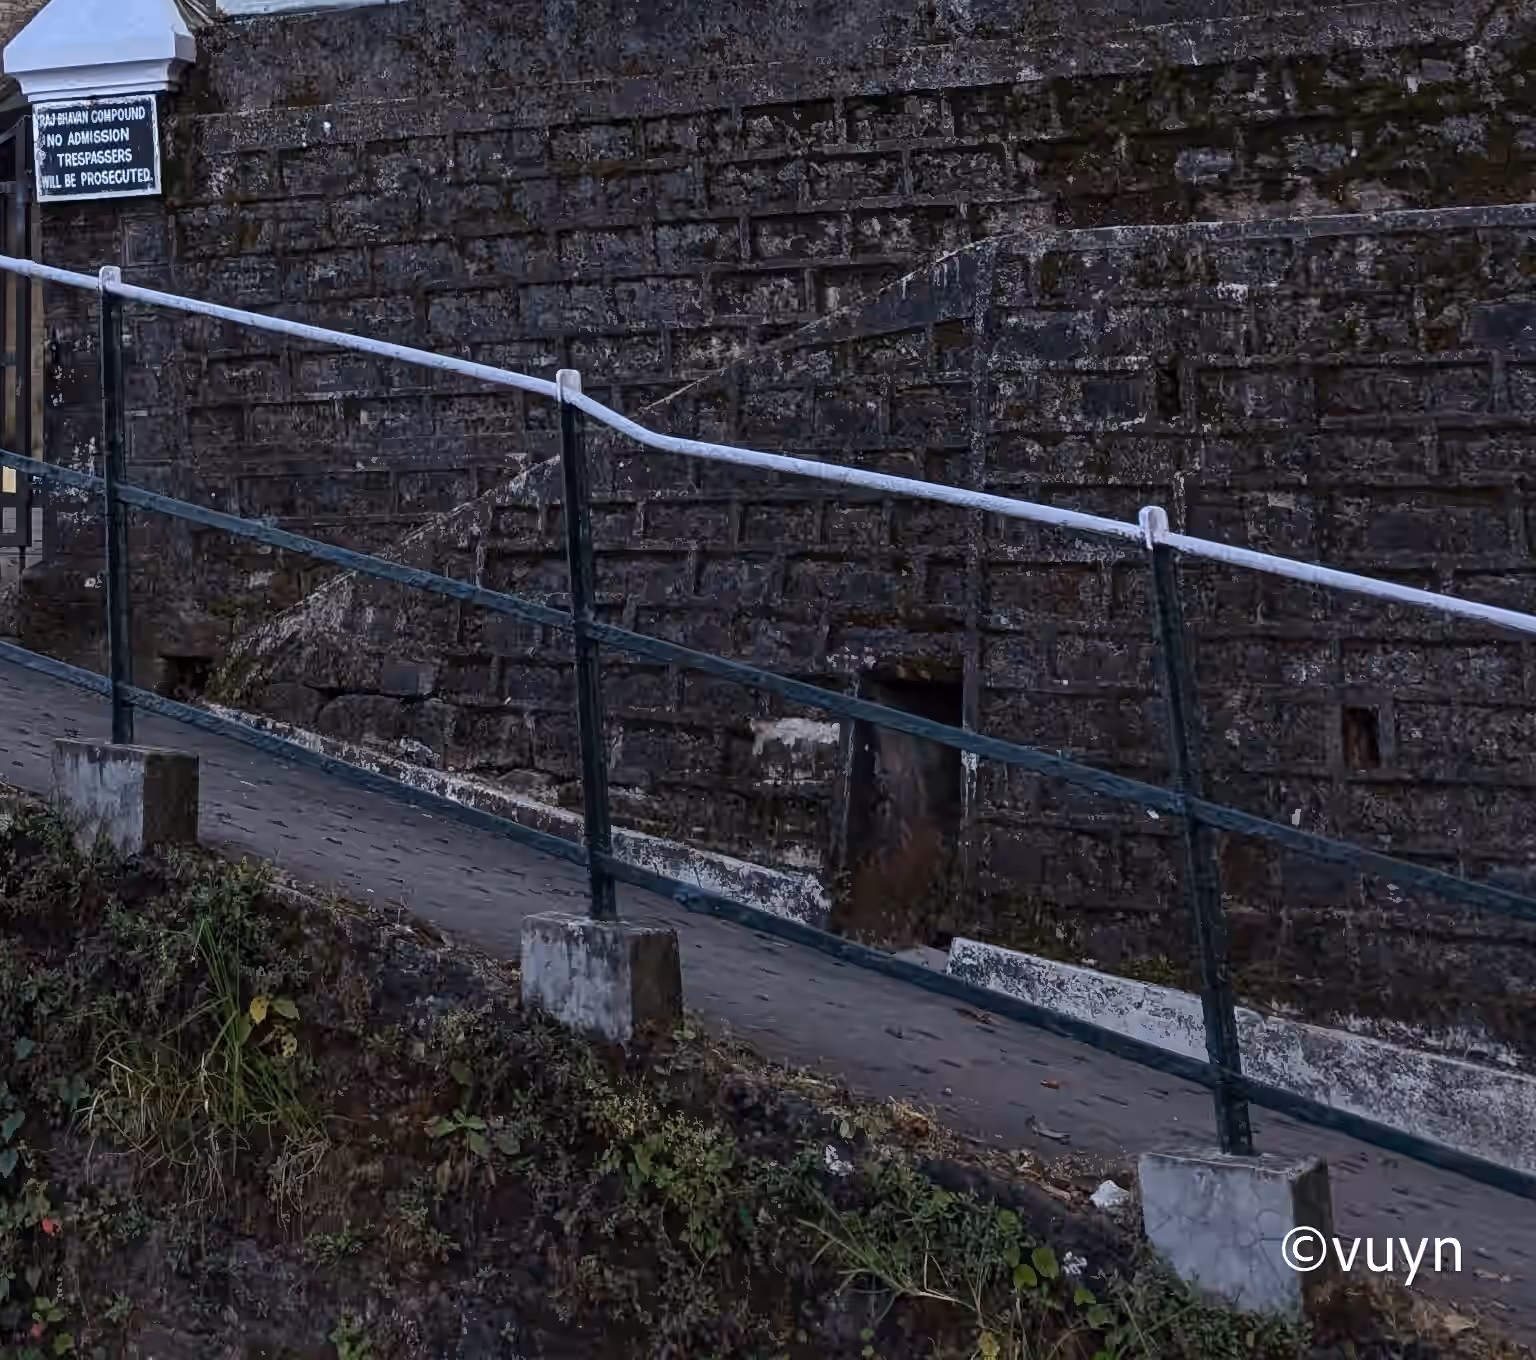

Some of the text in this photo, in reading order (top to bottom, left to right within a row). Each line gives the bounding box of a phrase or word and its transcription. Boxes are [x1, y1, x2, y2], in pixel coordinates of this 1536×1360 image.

[91, 106, 145, 123] COMPOUND
[46, 127, 129, 147] NO ADMISSION
[57, 149, 132, 168] TRESPASSERS
[41, 175, 62, 189] WILL
[64, 173, 76, 187] BE
